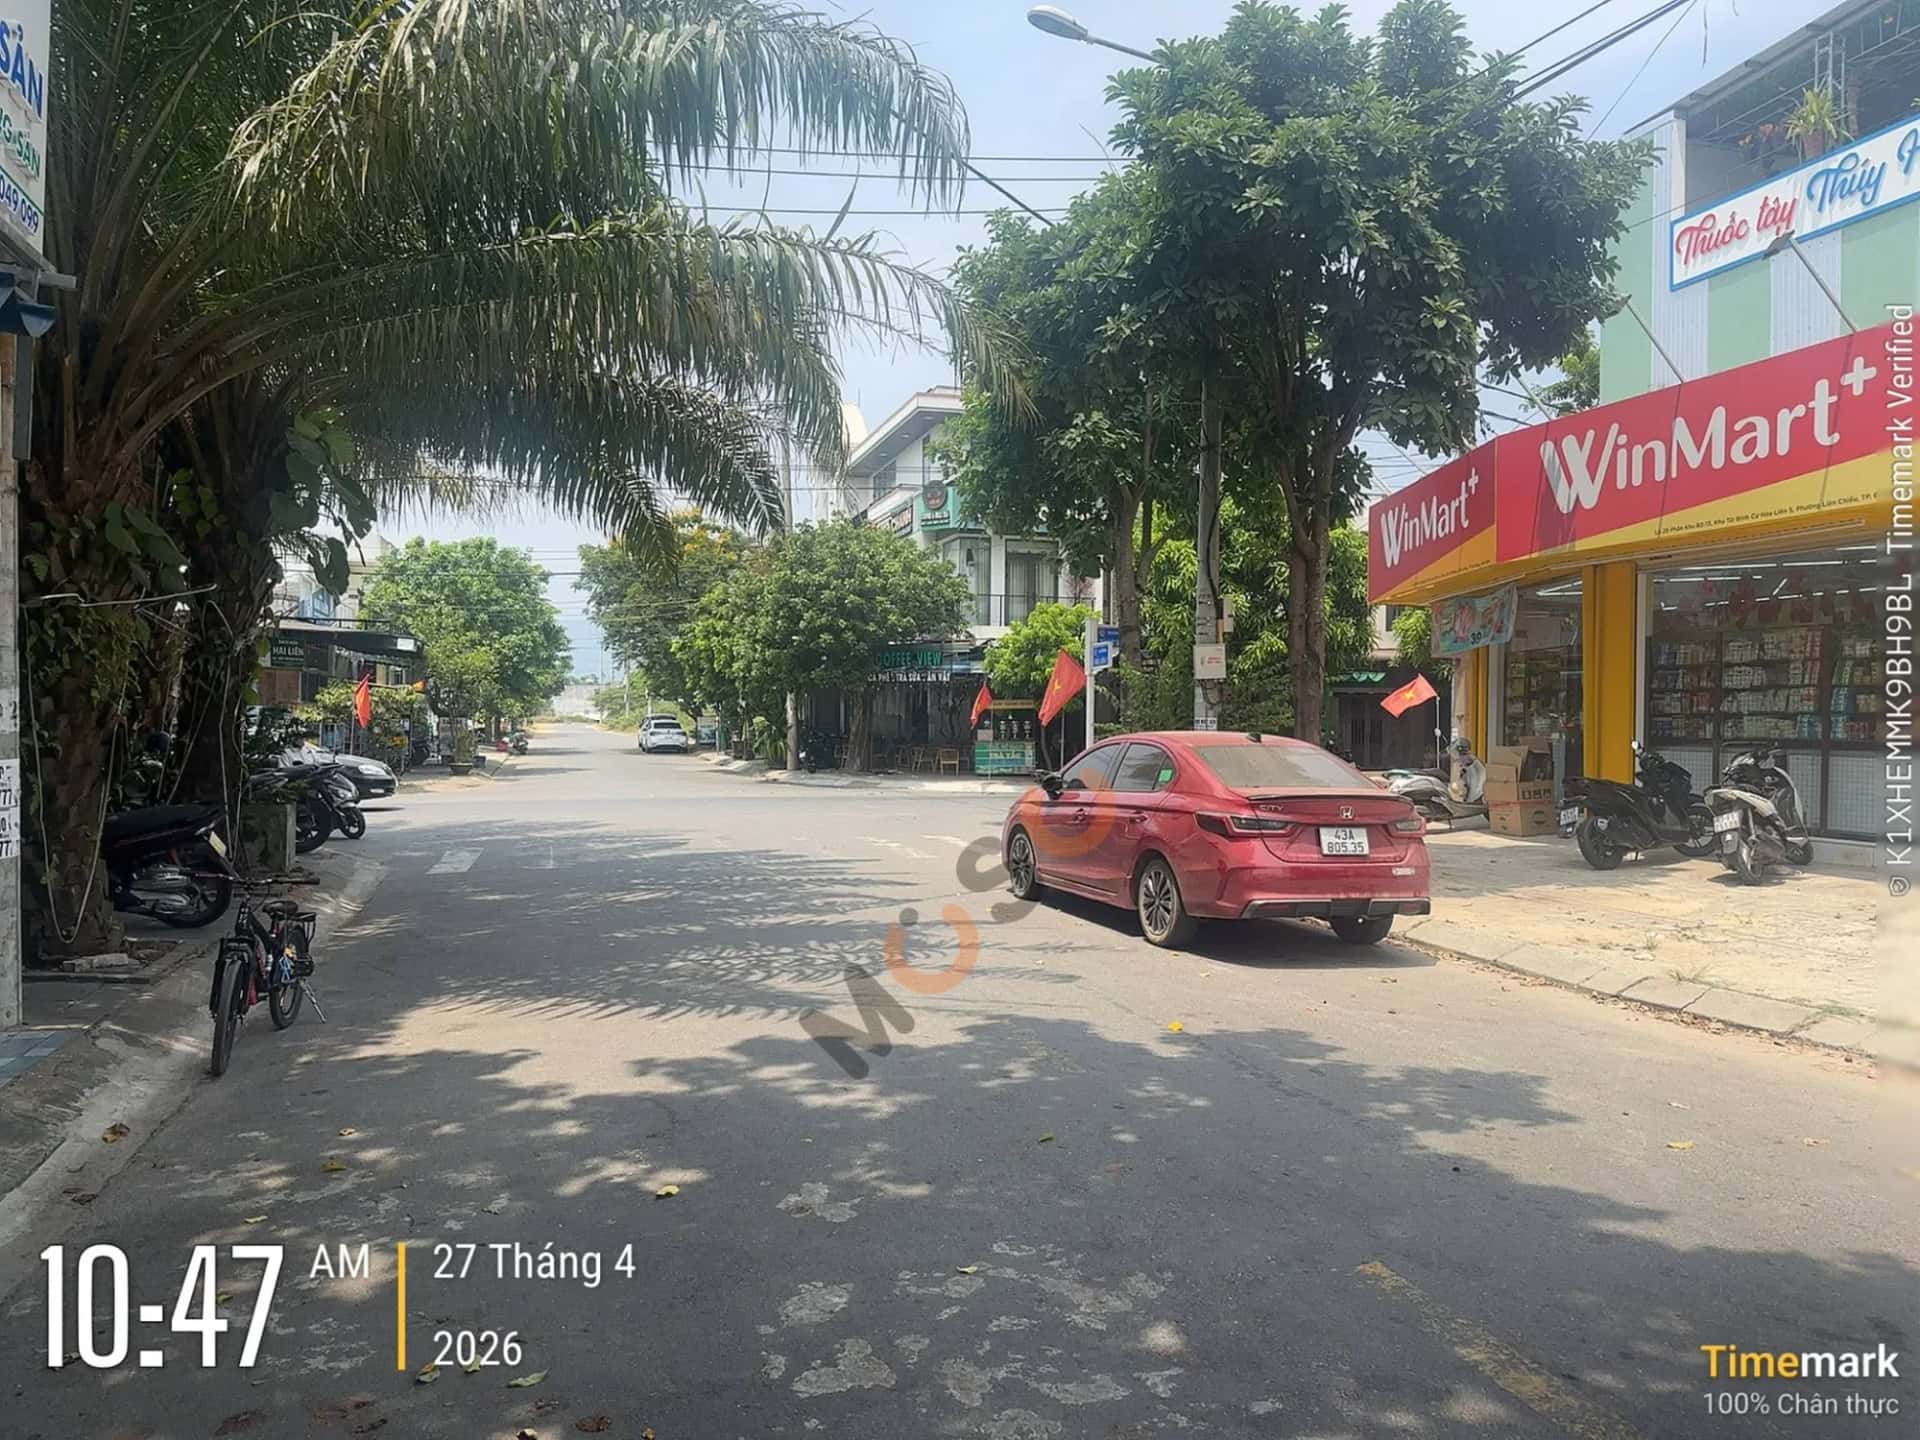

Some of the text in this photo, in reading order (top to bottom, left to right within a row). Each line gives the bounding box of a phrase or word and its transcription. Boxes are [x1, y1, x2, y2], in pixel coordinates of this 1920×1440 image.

[1676, 213, 1750, 265] Thuốc
[1756, 196, 1797, 235] tây
[916, 650, 942, 666] VIEW
[1260, 804, 1284, 812] CITY
[1334, 829, 1354, 840] 43A
[1327, 841, 1364, 853] 805.35
